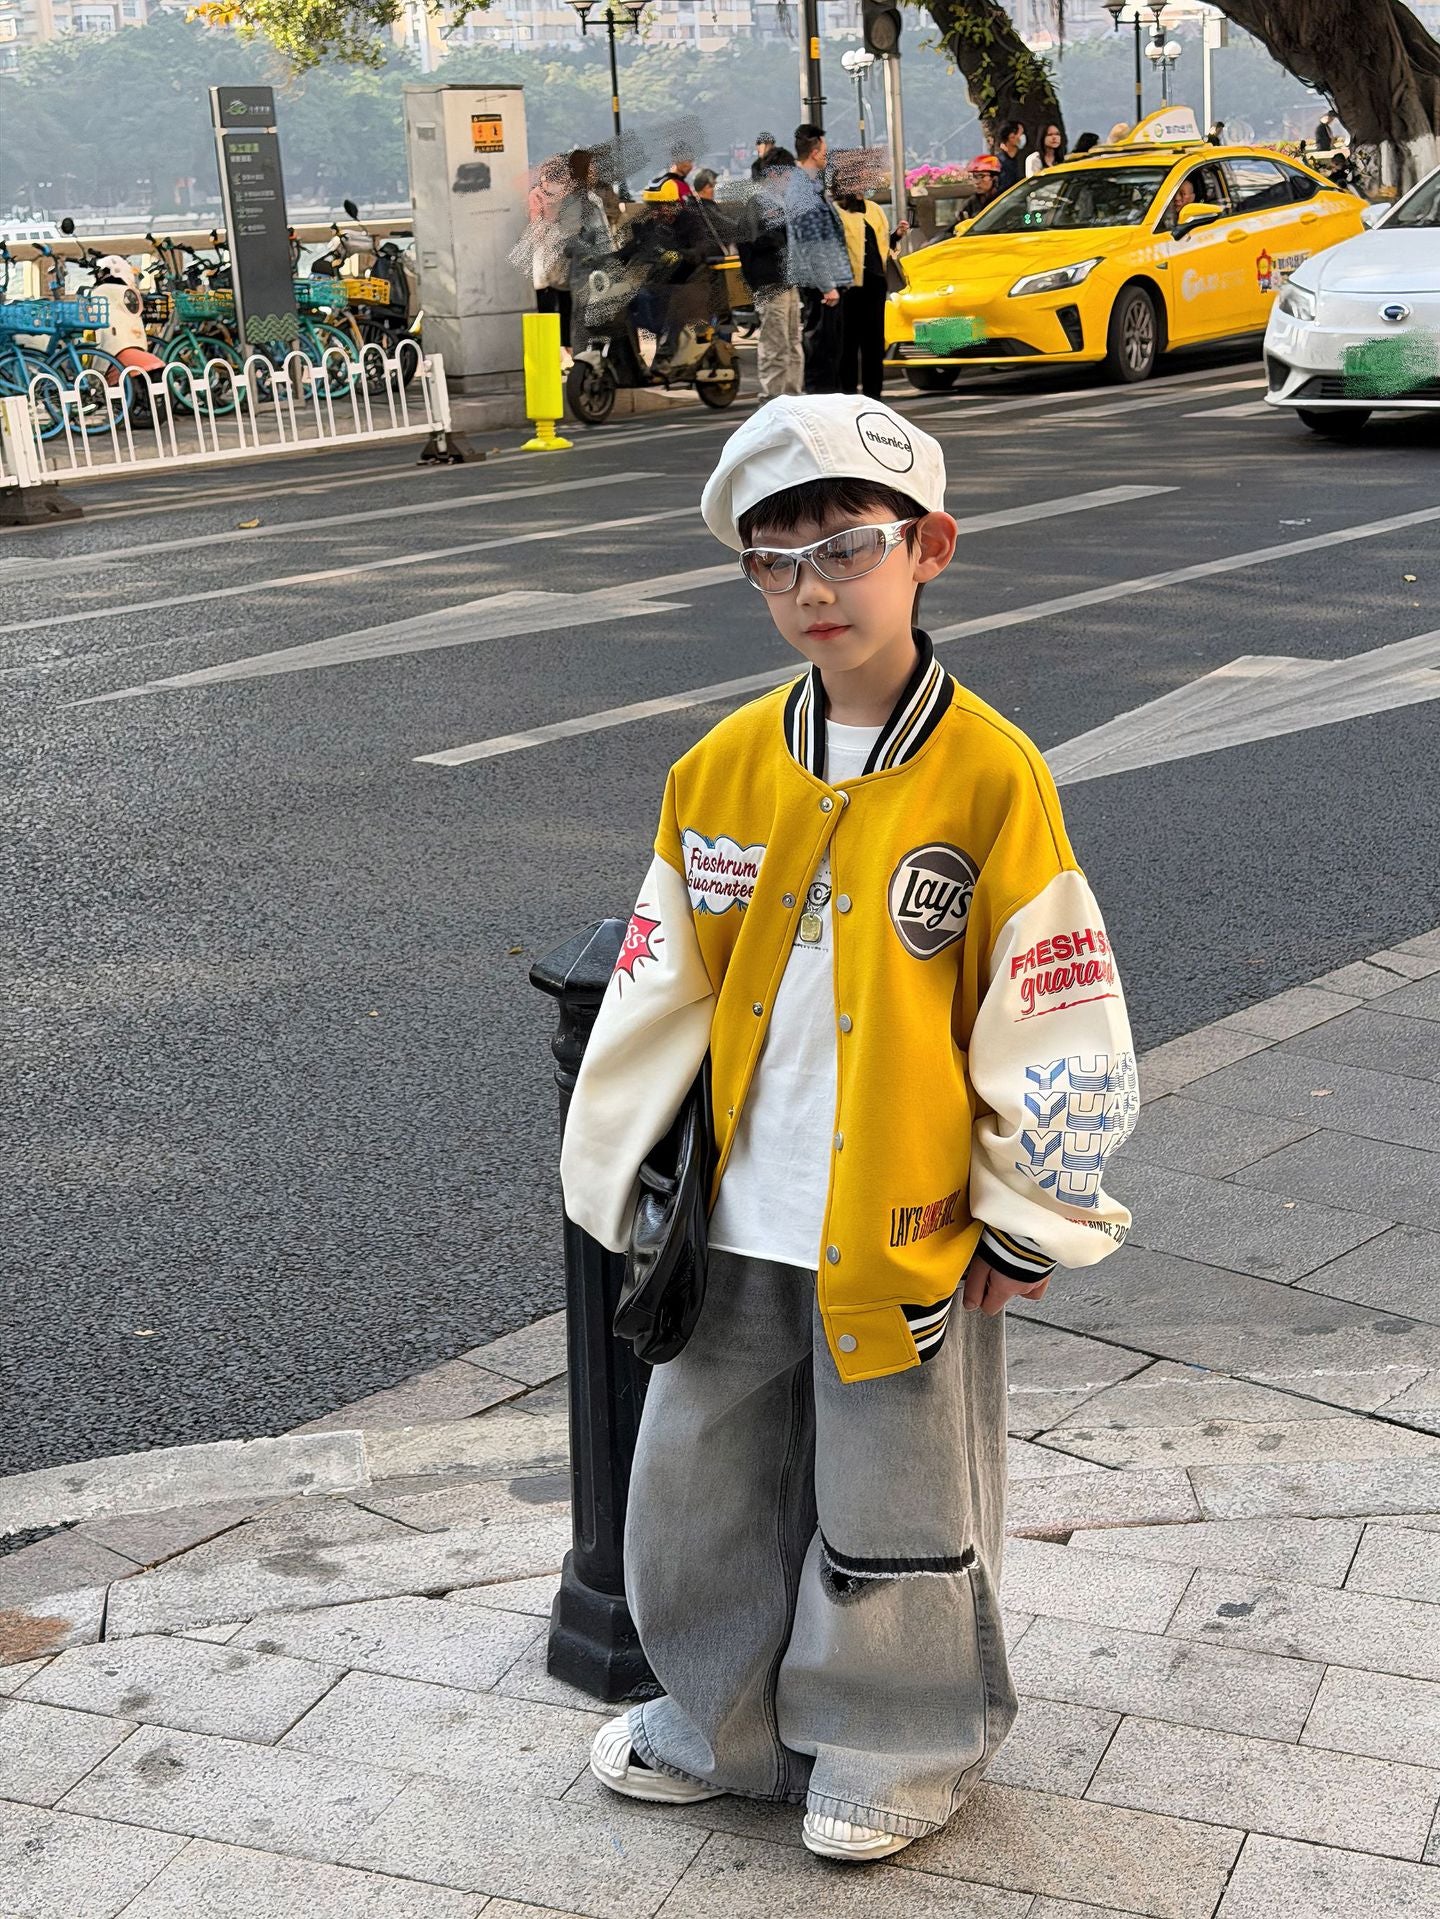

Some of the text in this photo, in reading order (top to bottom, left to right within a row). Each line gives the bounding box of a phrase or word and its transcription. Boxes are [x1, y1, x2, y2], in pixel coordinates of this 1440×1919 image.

[865, 430, 912, 453] thisnice
[898, 870, 973, 929] Lay's
[889, 1206, 924, 1248] LAY'S
